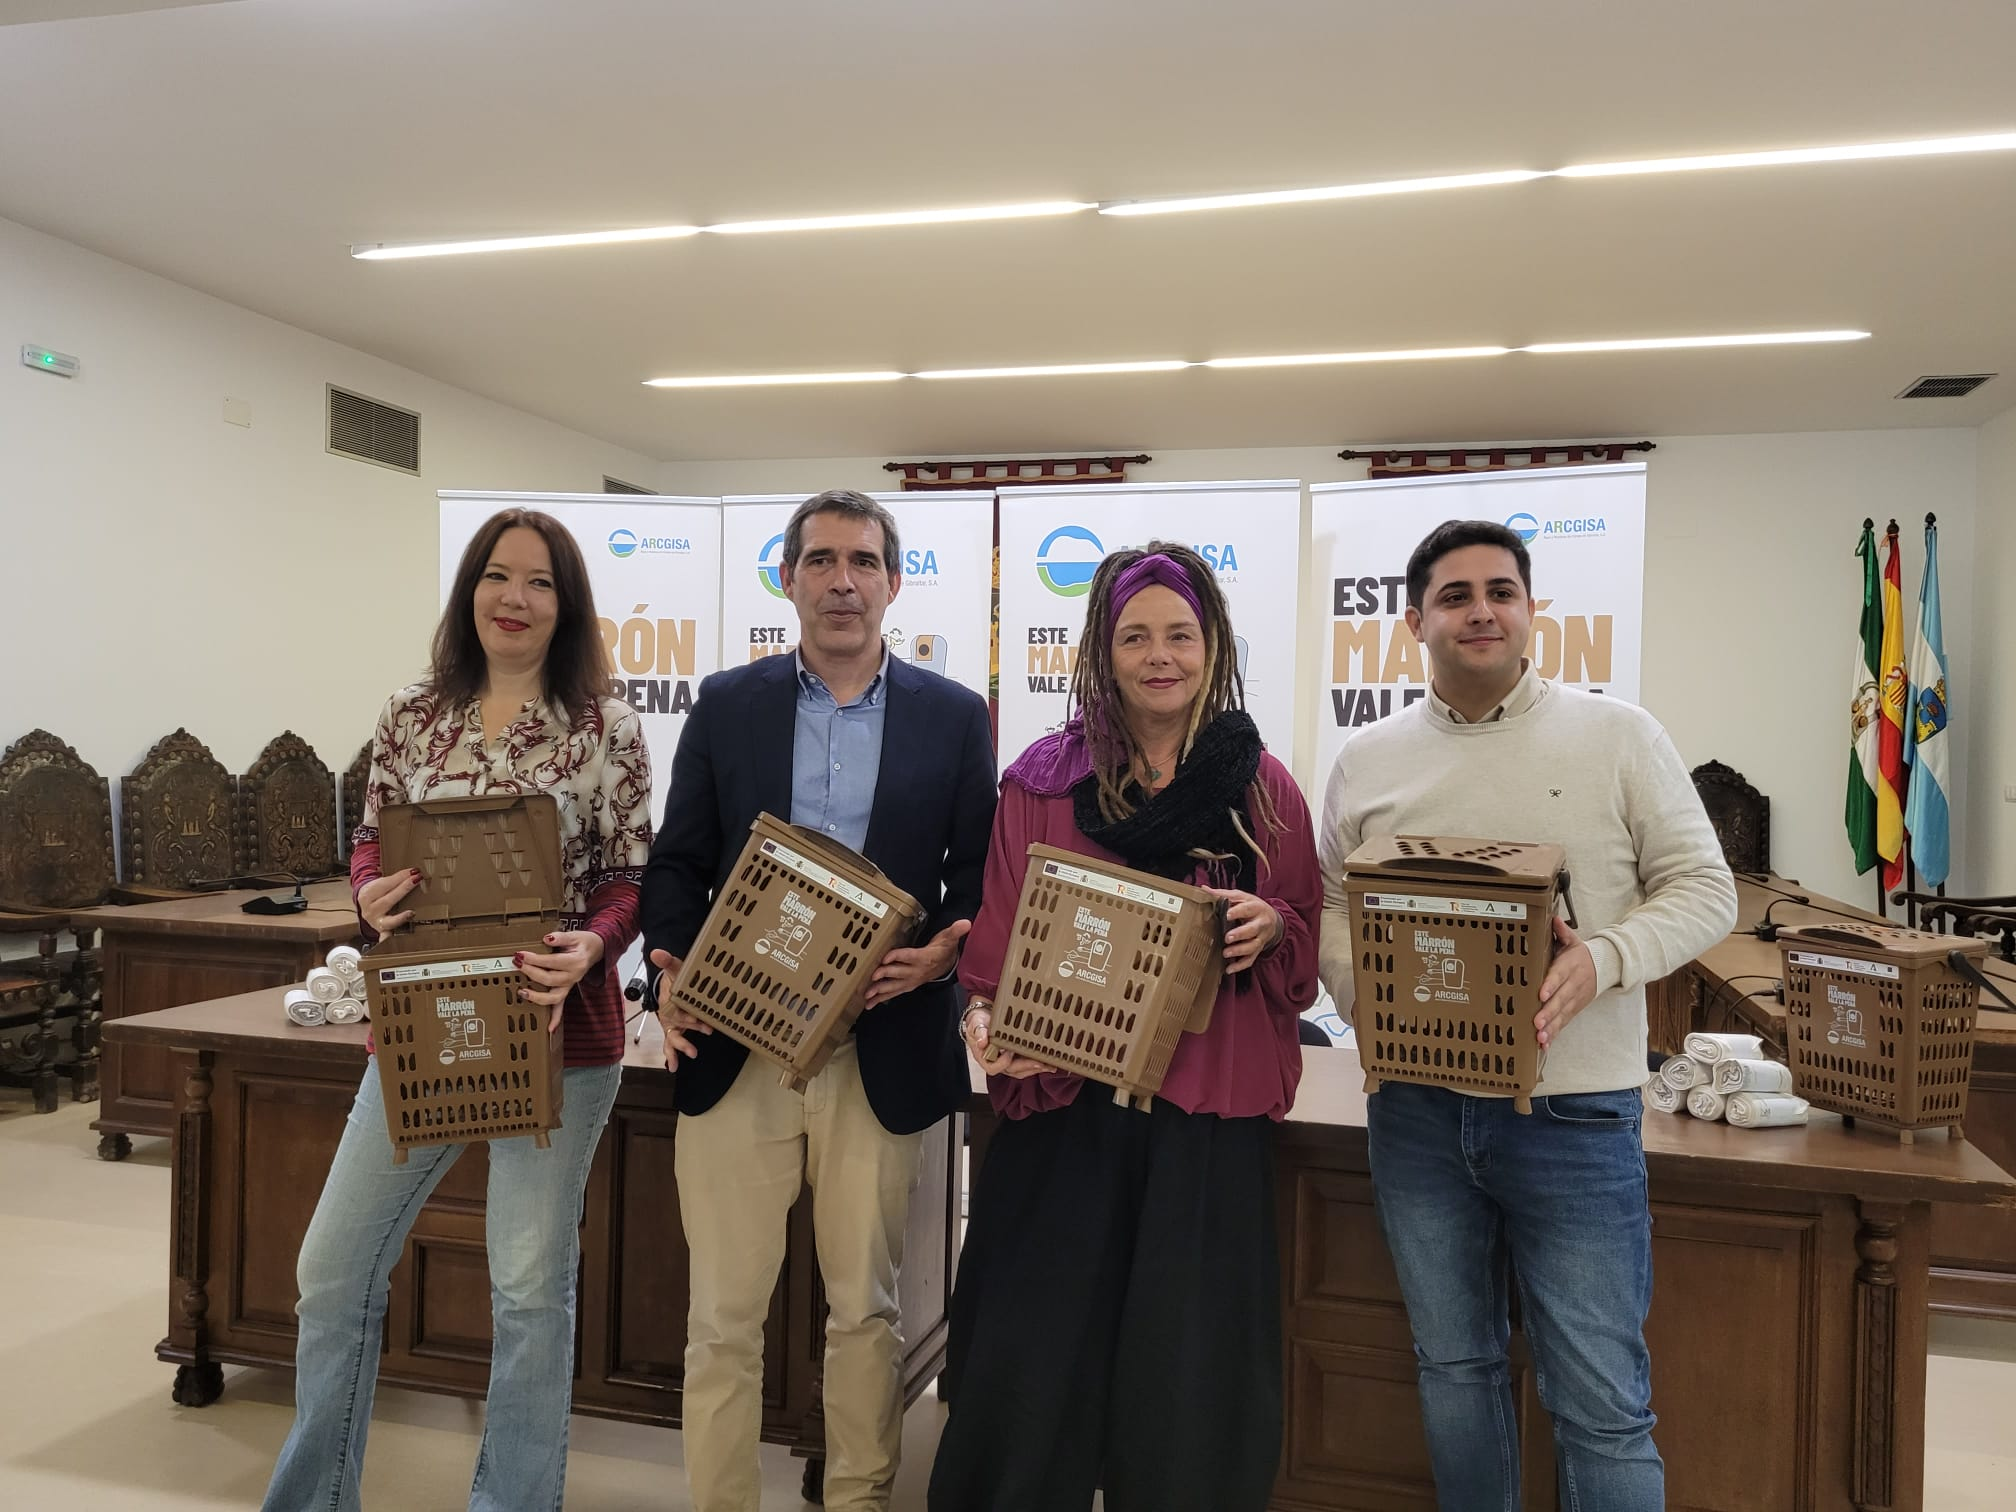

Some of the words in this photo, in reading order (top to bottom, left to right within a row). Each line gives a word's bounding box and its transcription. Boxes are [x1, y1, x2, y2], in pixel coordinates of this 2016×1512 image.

[1543, 518, 1606, 534] ARCGISA
[640, 538, 690, 550] ARCGISA
[1334, 576, 1406, 616] EST
[750, 627, 786, 643] ESTE
[1028, 627, 1068, 644] ESTE
[1028, 676, 1067, 693] VALE
[782, 895, 817, 921] MARRÓN
[1075, 912, 1111, 931] MARRÓN
[1415, 936, 1455, 949] MARRÓN
[771, 949, 799, 969] ARCGISA
[1076, 969, 1106, 984] ARCGISA
[1434, 990, 1470, 1002] ARCGISA
[437, 999, 475, 1012] MARRÓN
[459, 1049, 491, 1058] ARCGISA
